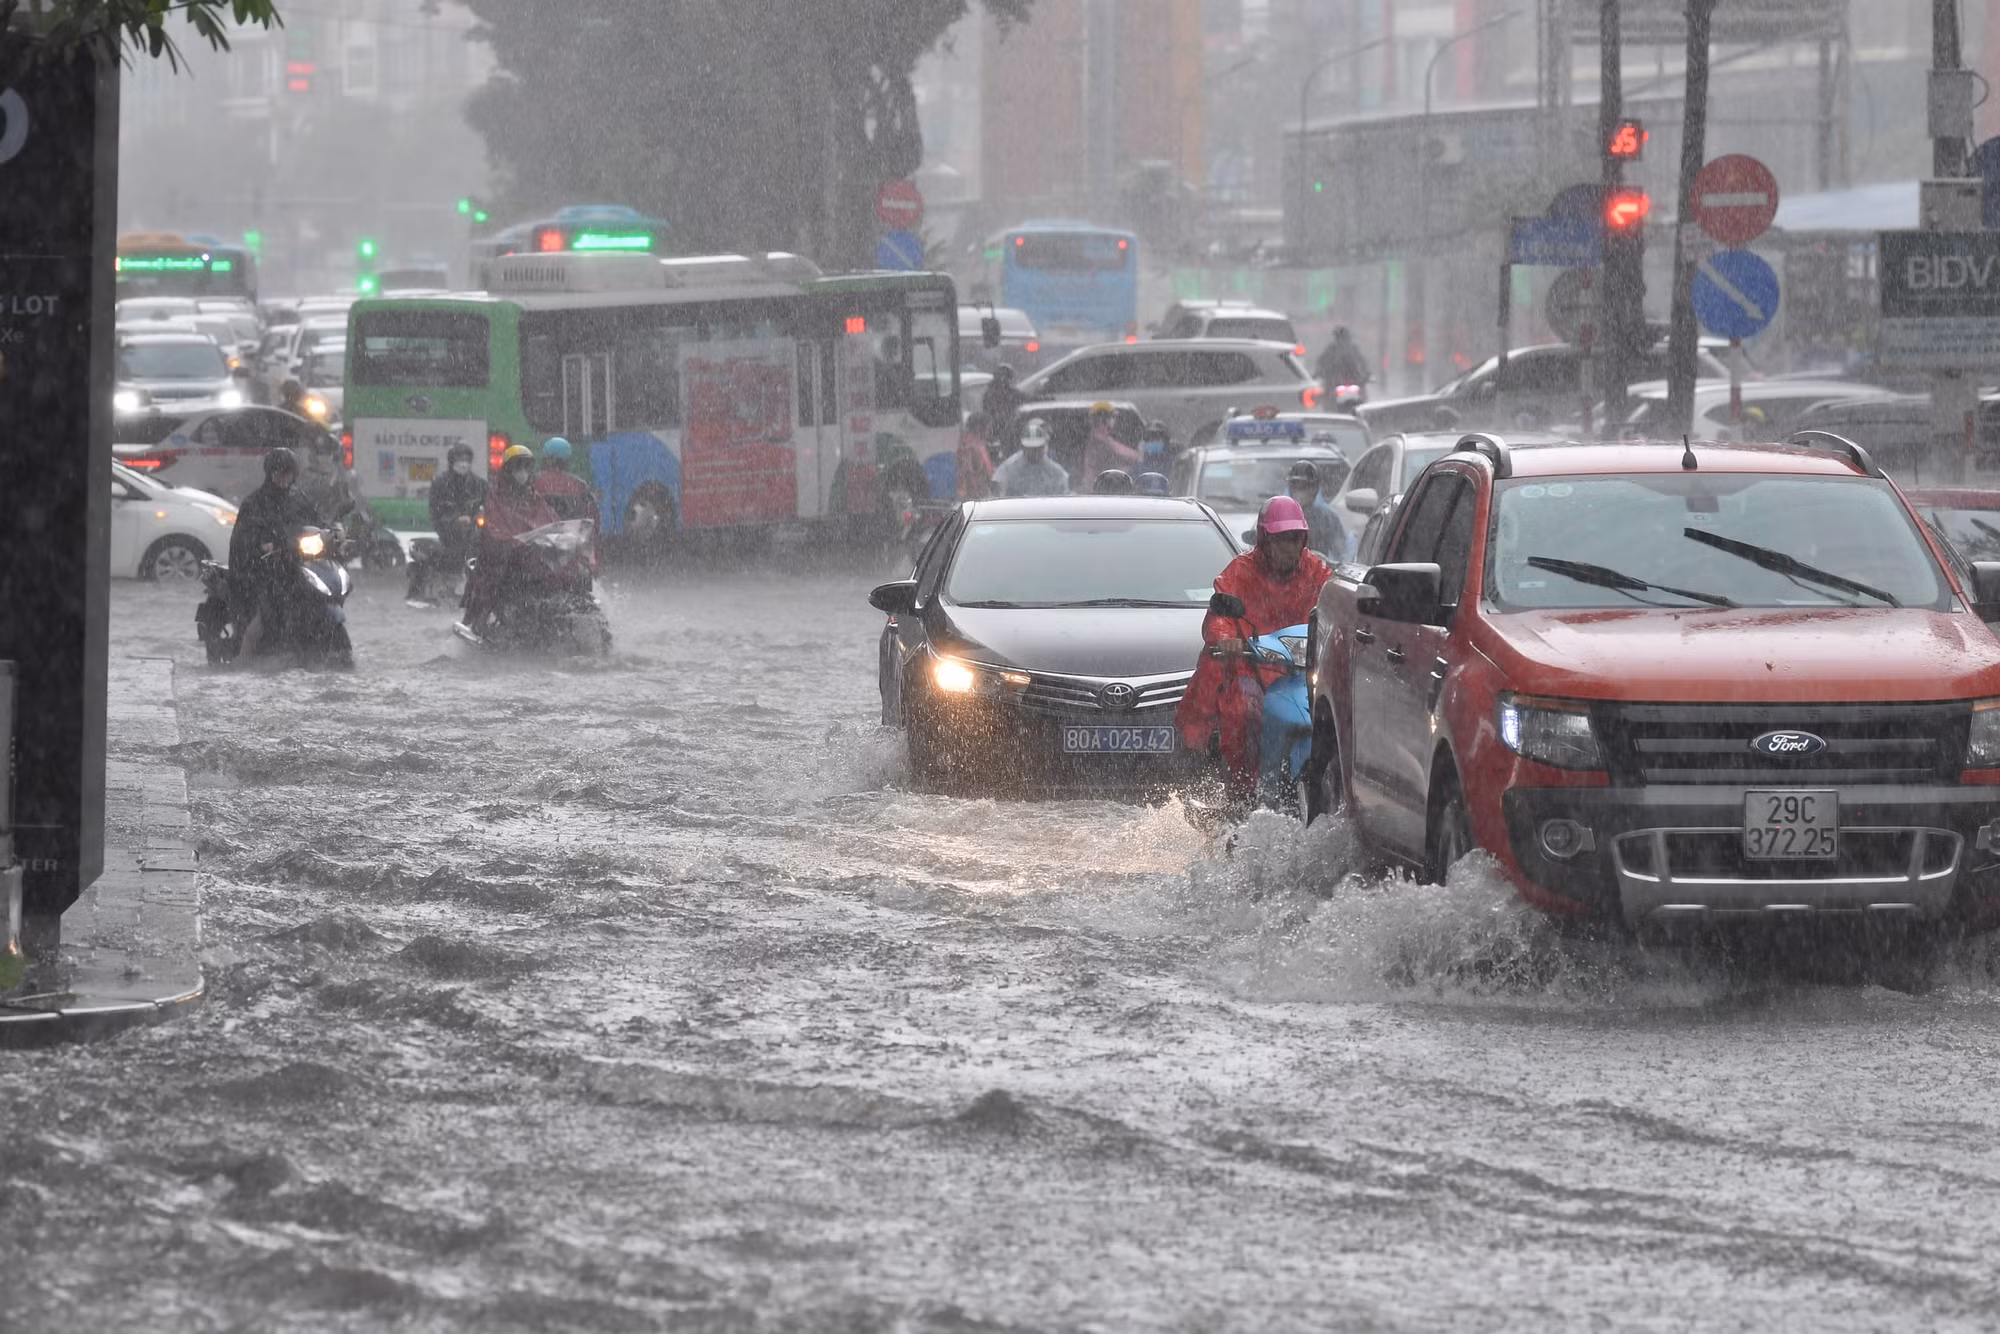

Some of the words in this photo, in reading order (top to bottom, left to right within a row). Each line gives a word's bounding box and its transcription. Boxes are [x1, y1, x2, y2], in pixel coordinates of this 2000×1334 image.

[1907, 255, 1996, 288] BIDV
[12, 295, 59, 316] LOT
[1, 327, 25, 343] Xe
[1067, 729, 1170, 750] 80A-025.42
[1768, 735, 1809, 752] Ford
[1767, 796, 1816, 824] 29C
[1748, 827, 1835, 856] 372.25
